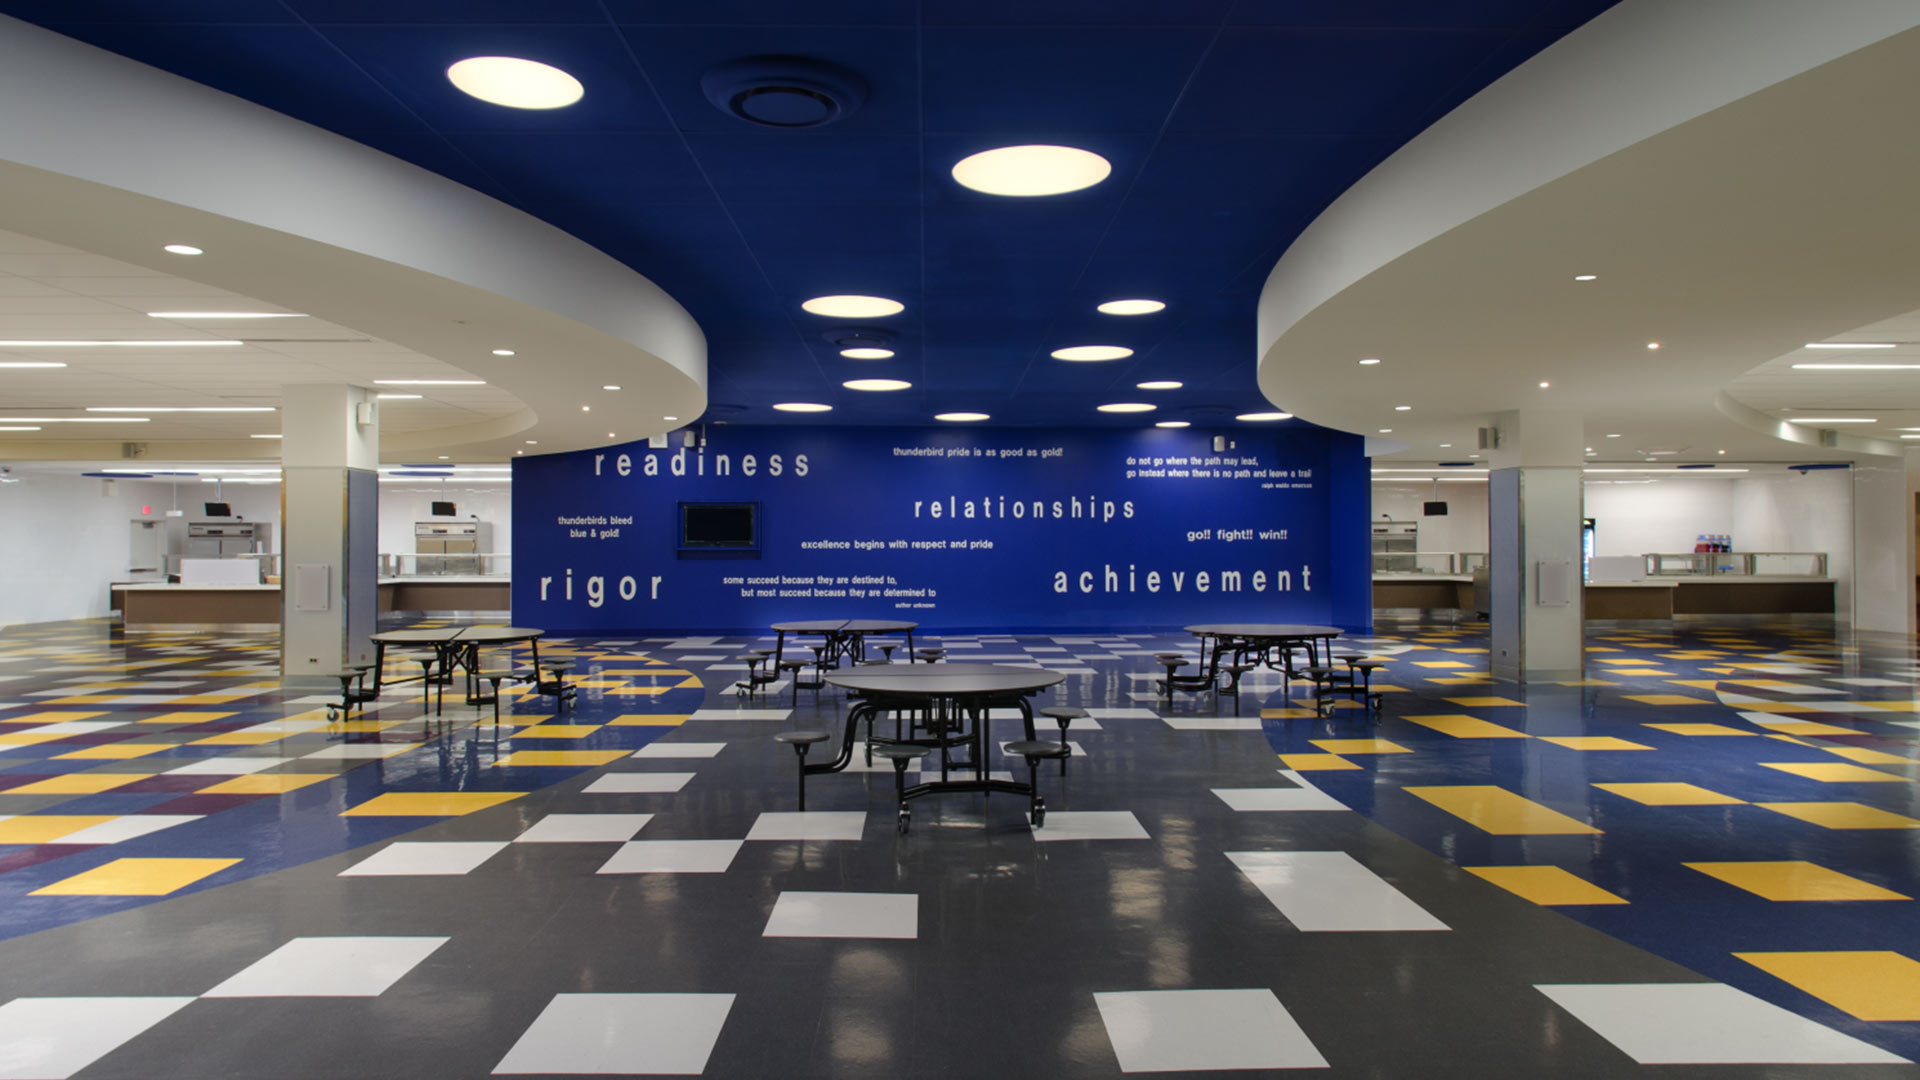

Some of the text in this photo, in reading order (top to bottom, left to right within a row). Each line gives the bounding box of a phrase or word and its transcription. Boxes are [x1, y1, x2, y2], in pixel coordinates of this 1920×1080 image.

[893, 446, 1063, 459] thunderbird pride is as good as gold!
[594, 448, 809, 476] readiness
[1126, 456, 1259, 467] do not go where the path may lead,
[1138, 468, 1166, 478] instead
[1168, 468, 1189, 478] where
[1191, 468, 1211, 478] there
[1234, 469, 1251, 479] path
[1253, 469, 1267, 478] and
[1269, 469, 1288, 478] leave
[1298, 469, 1311, 478] trail
[914, 495, 1135, 523] relationships
[558, 515, 633, 525] thunderbirds bleed
[570, 528, 620, 540] blue & gold!
[1187, 529, 1288, 542] go!! fight!! win!!
[801, 539, 994, 552] excellence begins with respect and pride
[723, 575, 898, 587] some succeed because they are destined to,
[1053, 564, 1312, 594] achievement
[540, 568, 662, 608] rigor
[741, 588, 937, 599] but most succeed because they are determined to
